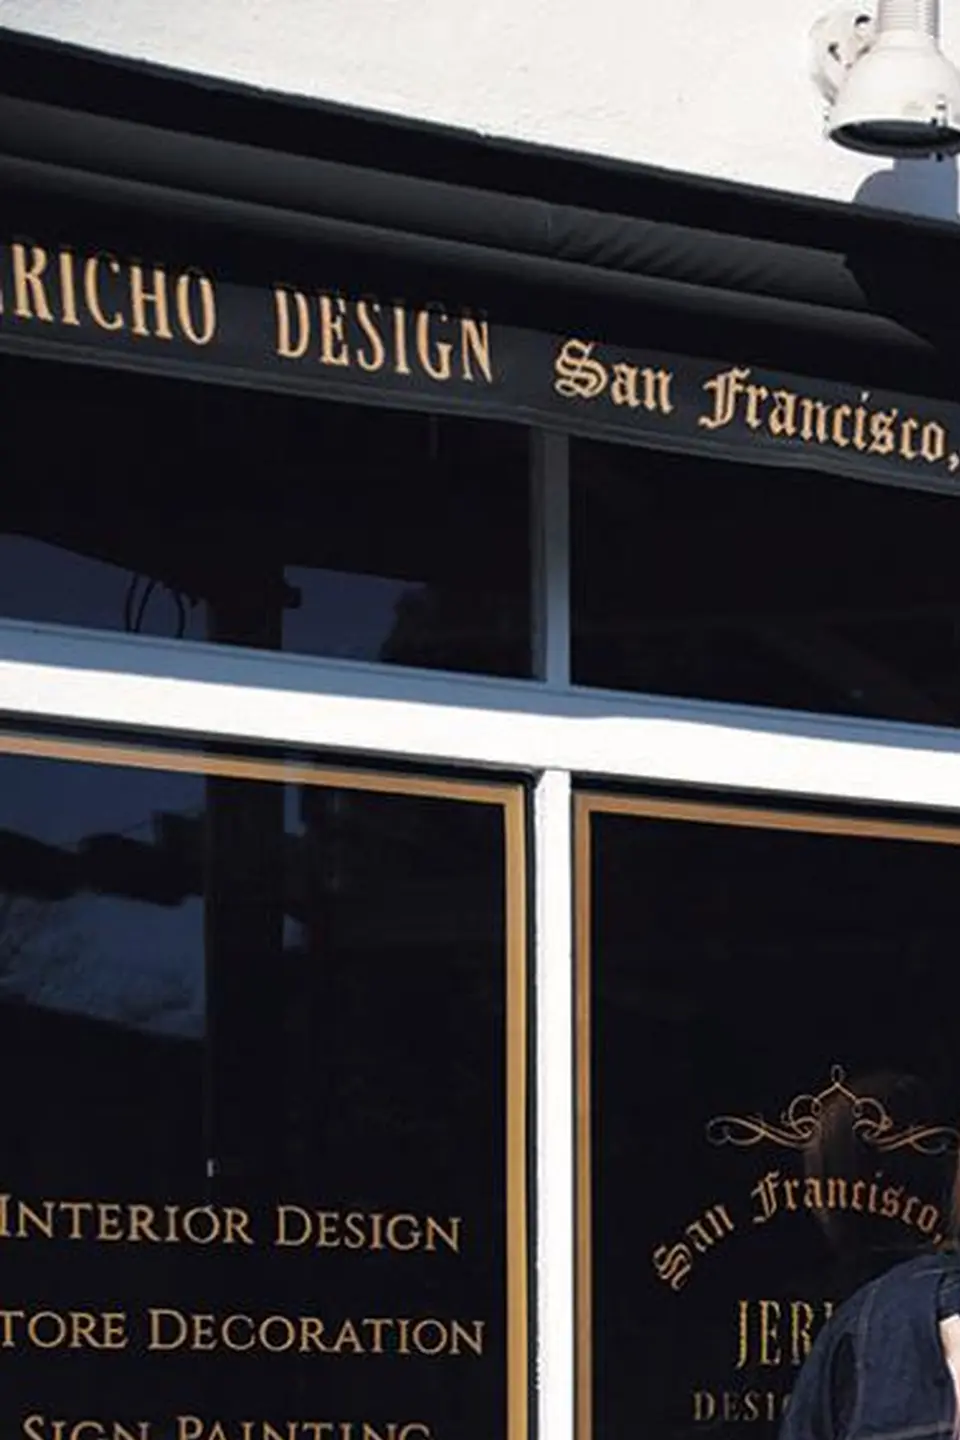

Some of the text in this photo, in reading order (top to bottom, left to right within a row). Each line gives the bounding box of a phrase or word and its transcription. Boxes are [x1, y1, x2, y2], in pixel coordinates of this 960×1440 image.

[0, 243, 217, 346] RICHO
[275, 288, 494, 384] DESIGN
[553, 337, 675, 415] San
[697, 366, 960, 473] Francisco,
[652, 1203, 736, 1292] San
[0, 1309, 129, 1350] TORE
[693, 1390, 793, 1422] DESI
